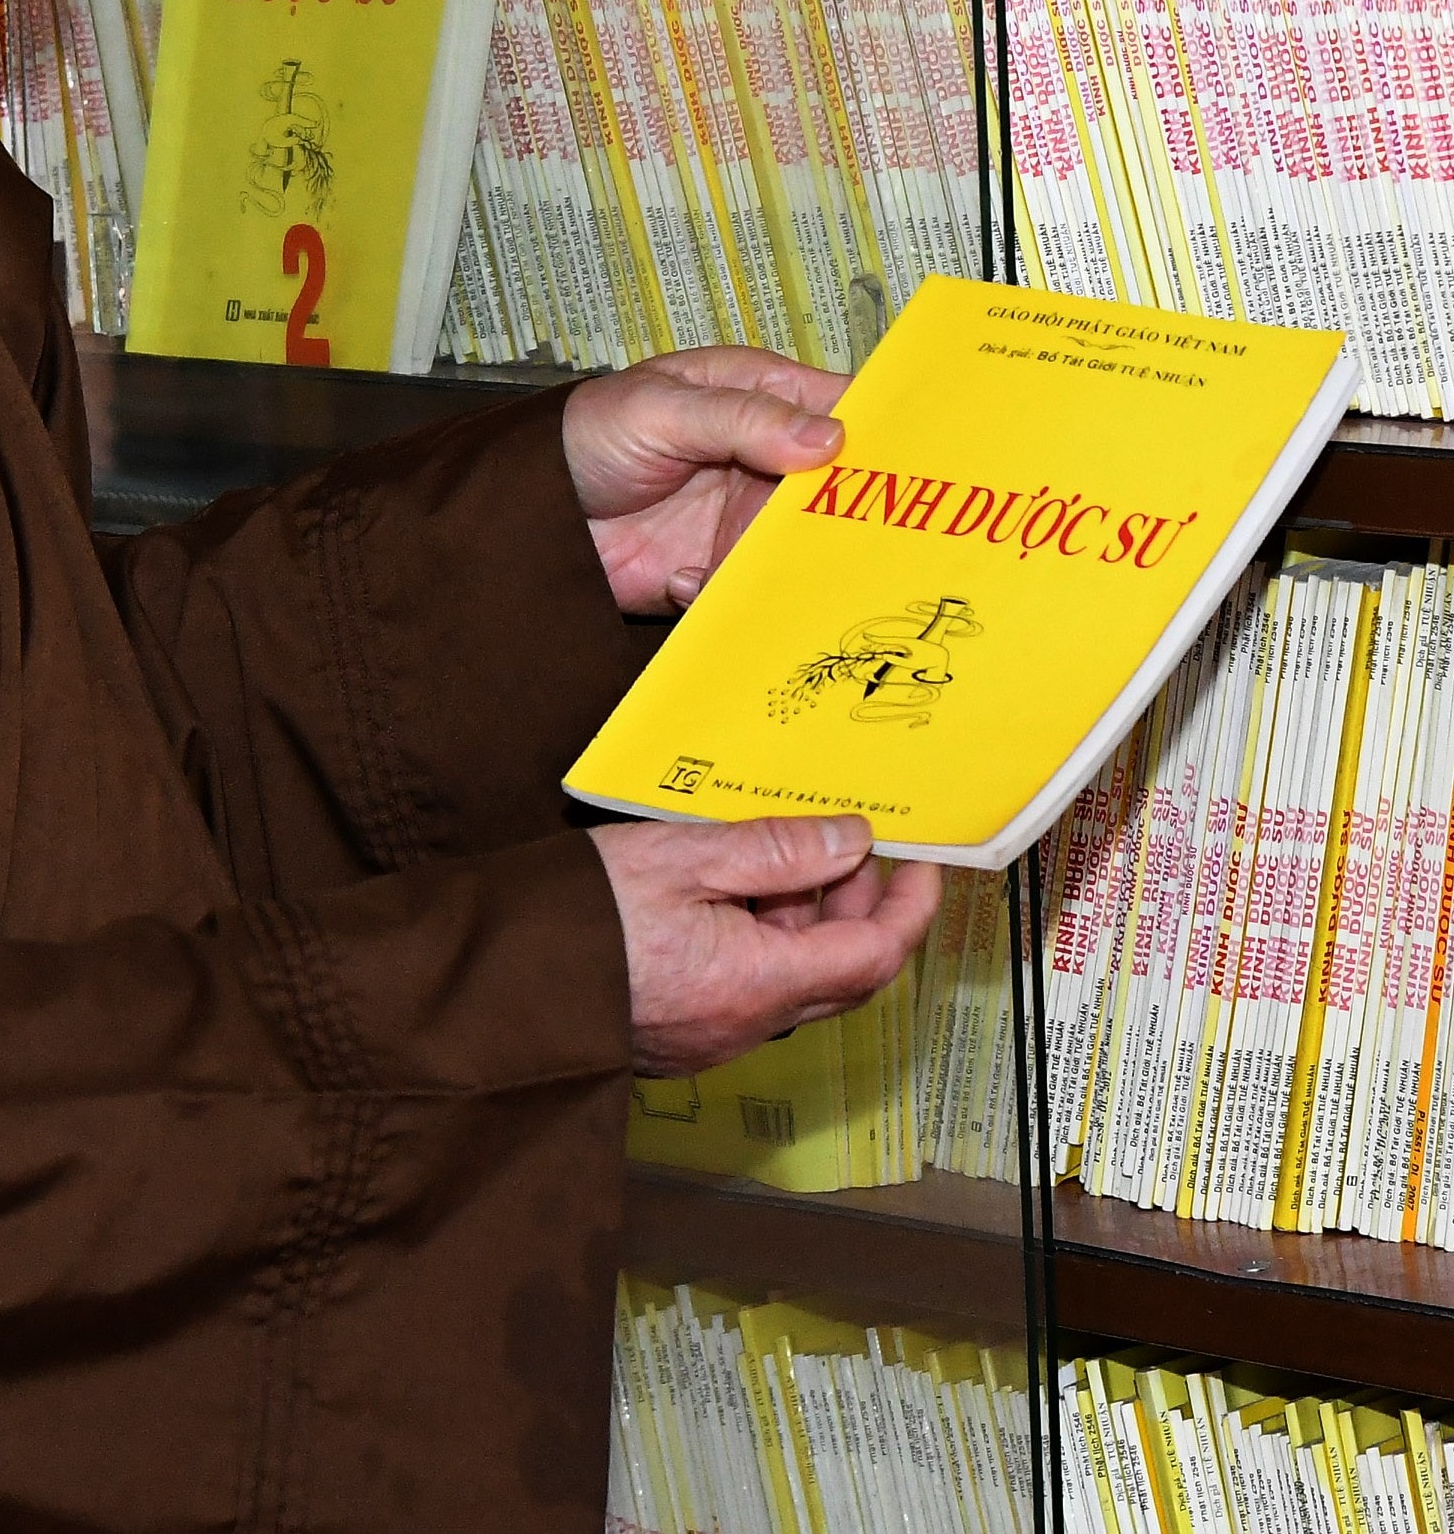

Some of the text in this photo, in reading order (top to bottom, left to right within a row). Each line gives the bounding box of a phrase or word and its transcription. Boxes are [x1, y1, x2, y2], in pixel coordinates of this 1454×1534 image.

[1079, 81, 1095, 123] KINH
[1089, 76, 1107, 117] KINH
[282, 223, 331, 365] 2
[987, 306, 1030, 321] GIÁO
[1115, 326, 1160, 342] GIÁO
[1207, 341, 1247, 356] NAM
[801, 465, 1198, 569] KINH DƯỢC SƯ
[1261, 613, 1271, 634] 2546
[1379, 907, 1393, 948] KINH
[1212, 933, 1229, 995] KINH
